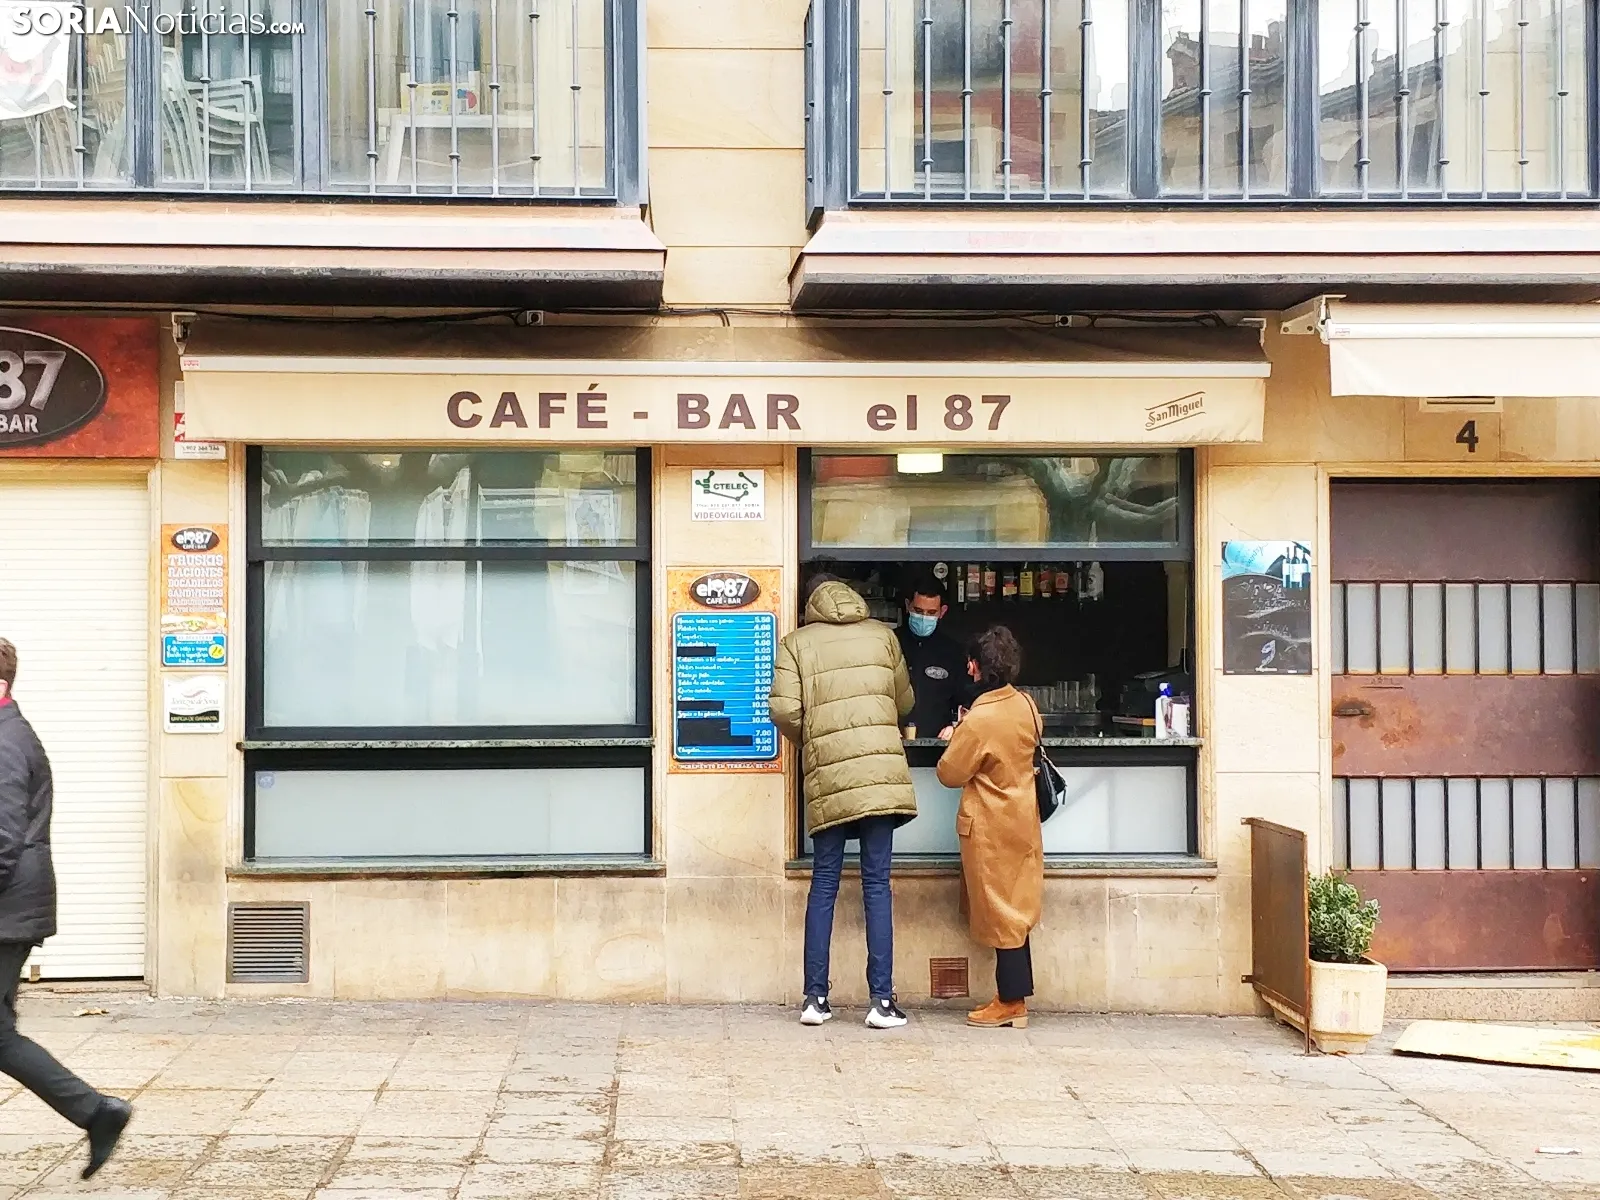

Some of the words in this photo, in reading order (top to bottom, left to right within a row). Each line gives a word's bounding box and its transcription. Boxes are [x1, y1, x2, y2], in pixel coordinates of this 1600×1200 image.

[447, 383, 608, 428] CAFÉ
[677, 393, 801, 430] BAR
[866, 394, 917, 431] el
[944, 394, 1011, 431] 87
[1456, 420, 1479, 453] 4
[694, 511, 762, 519] VIDEOVIGILADA
[168, 566, 223, 577] RACIONES
[168, 578, 223, 588] BOCADILLOS
